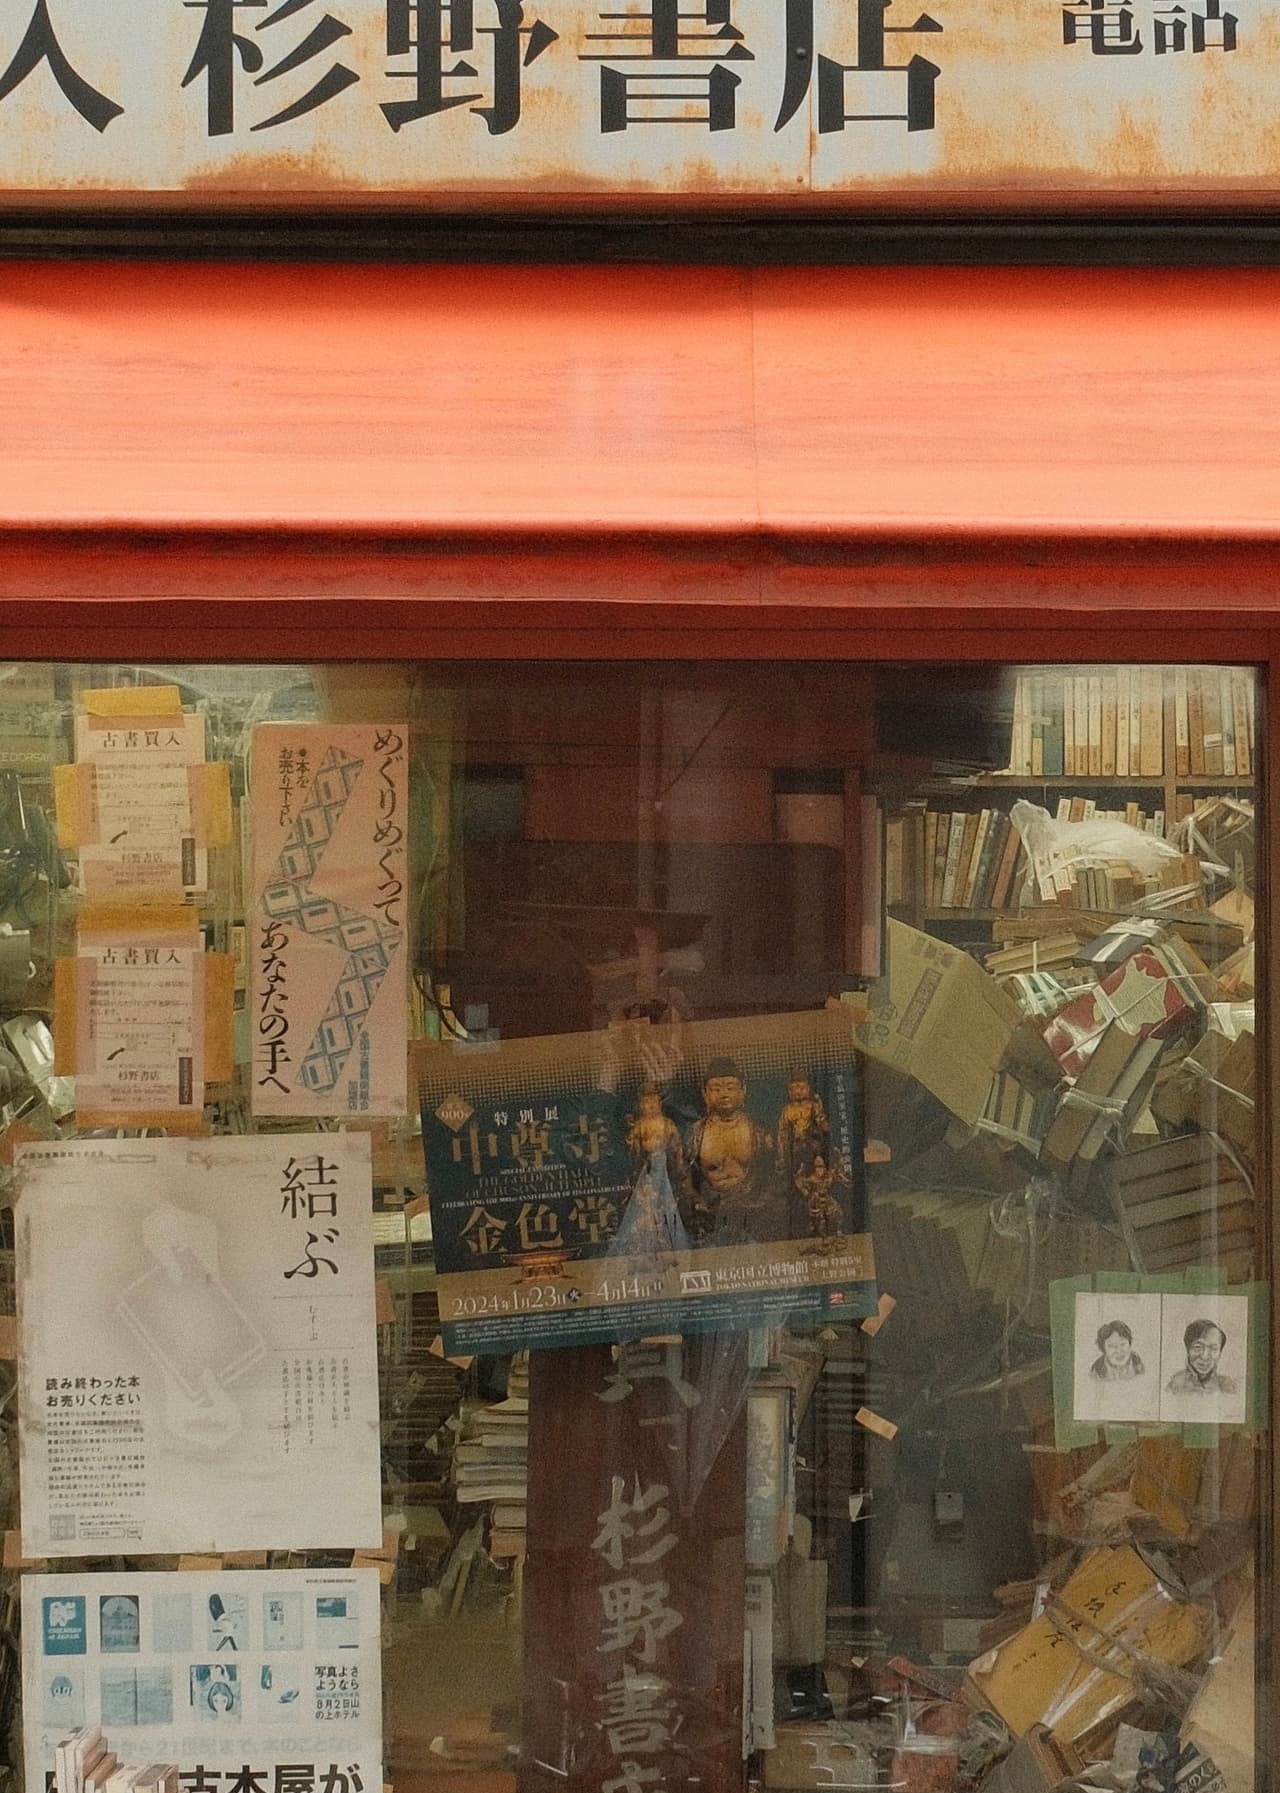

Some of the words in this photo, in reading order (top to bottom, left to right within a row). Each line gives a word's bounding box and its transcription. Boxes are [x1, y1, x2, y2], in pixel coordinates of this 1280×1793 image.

[100, 731, 181, 748] 古書買入
[373, 728, 404, 927] めぐりめぐって
[100, 947, 182, 965] 古書買入
[254, 922, 291, 1095] あなたの手へ
[280, 1156, 341, 1280] 結ぶ
[459, 1196, 618, 1254] 金色堂
[45, 1375, 141, 1391] 読み終わった本
[46, 1393, 141, 1408] お売りください
[315, 1665, 359, 1678] 写真よさ
[316, 1679, 360, 1691] ようなら
[317, 1698, 360, 1709] 8月2日山
[315, 1710, 360, 1720] の上ホテル
